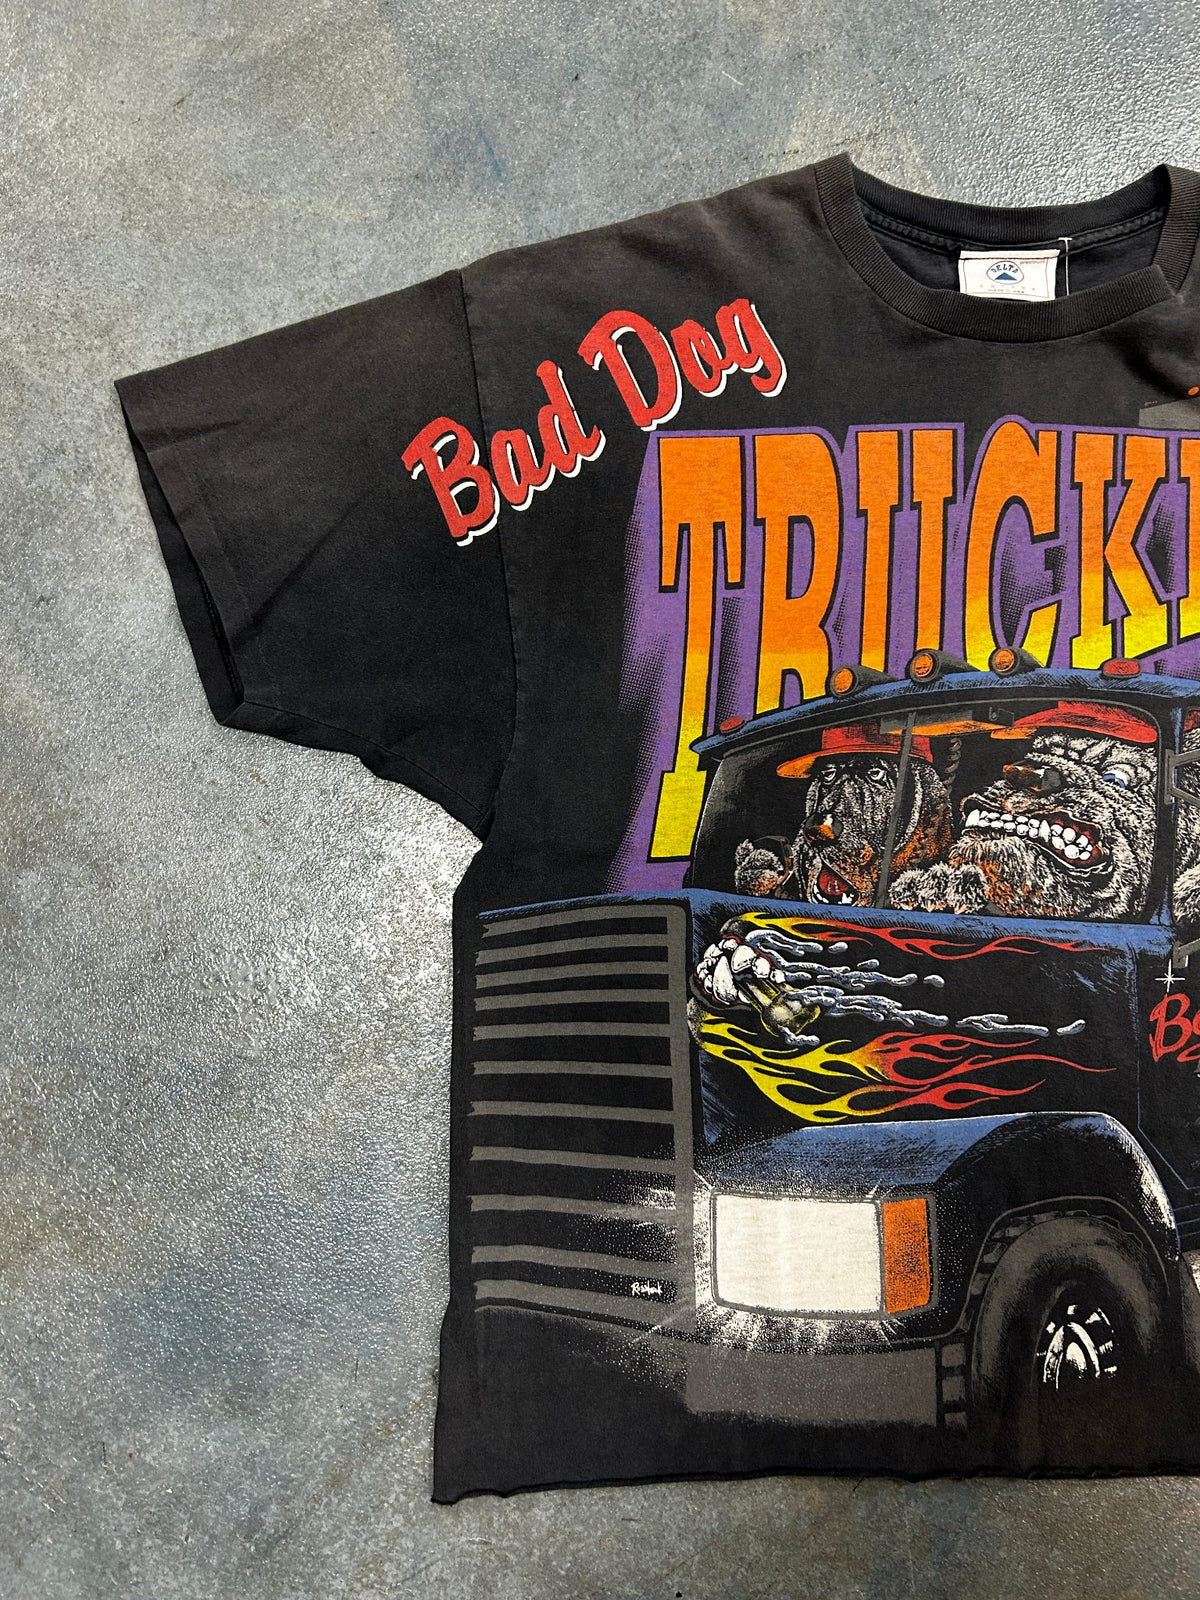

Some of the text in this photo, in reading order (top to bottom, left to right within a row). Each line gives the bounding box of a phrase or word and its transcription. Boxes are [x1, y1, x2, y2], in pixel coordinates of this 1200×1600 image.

[990, 263, 1019, 274] DELTA
[401, 298, 787, 547] Bad Dog
